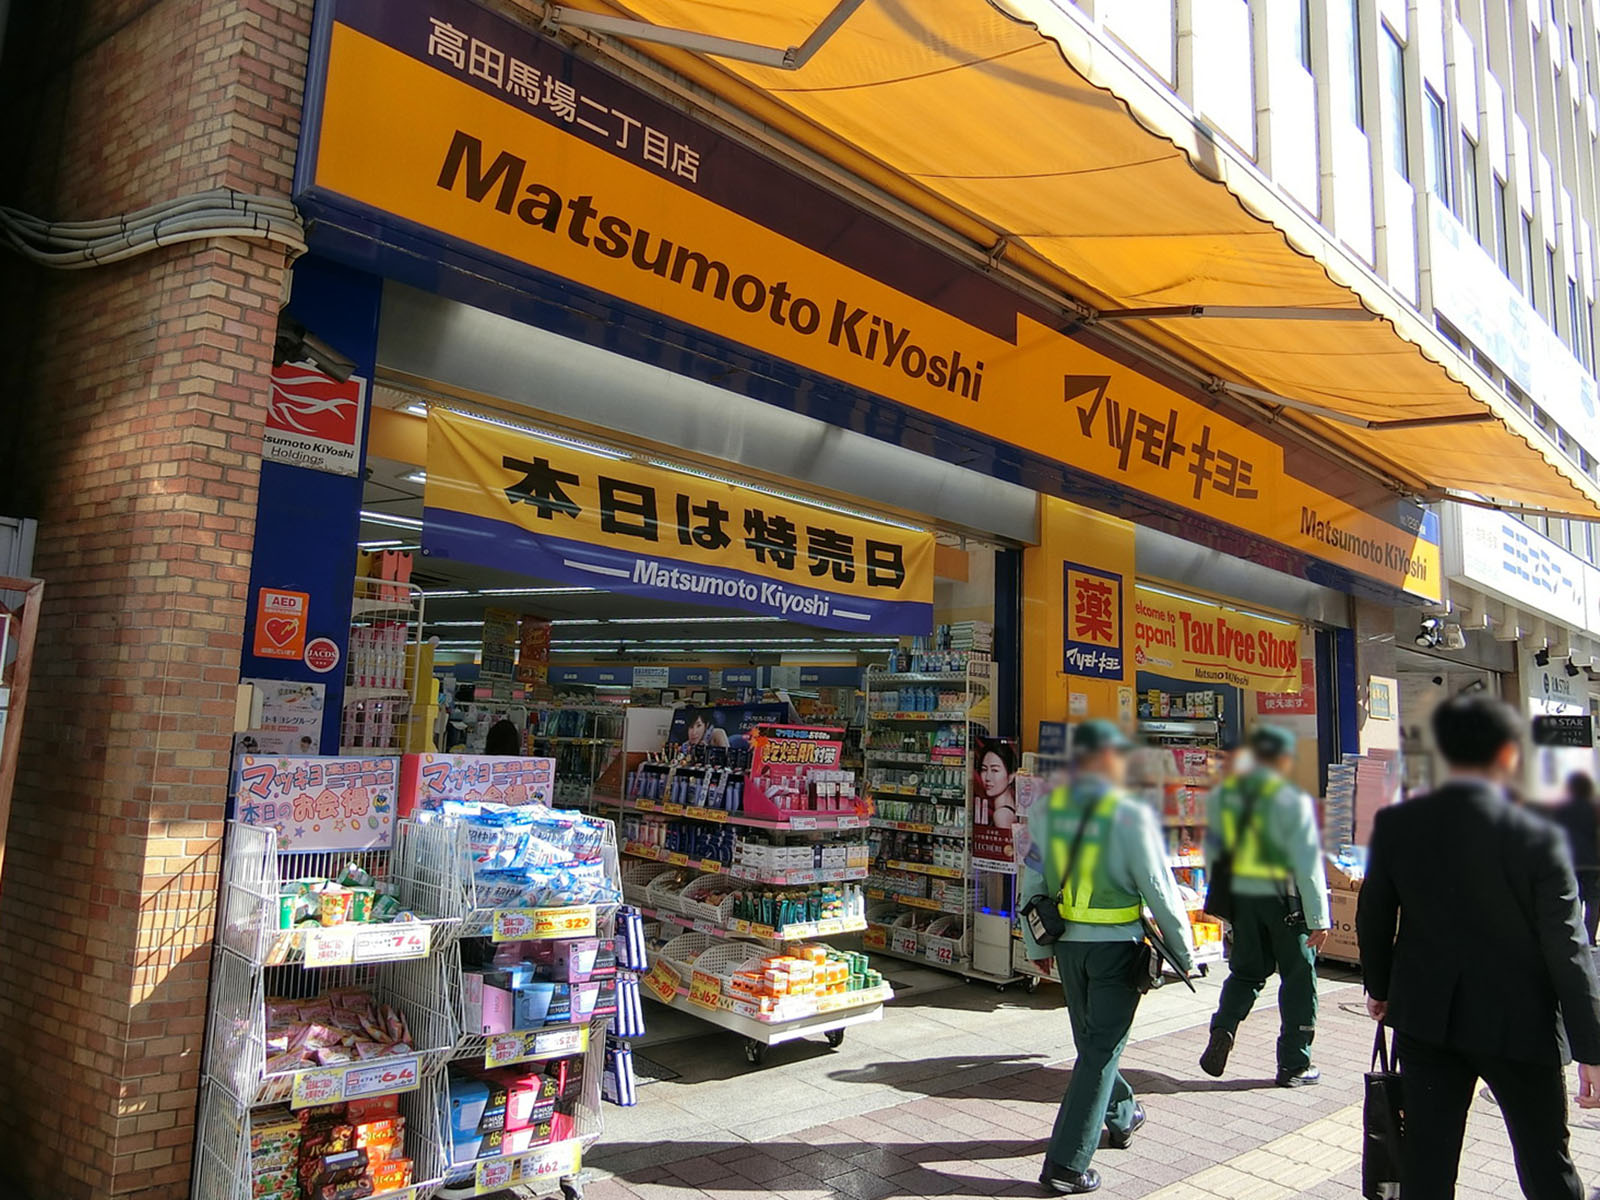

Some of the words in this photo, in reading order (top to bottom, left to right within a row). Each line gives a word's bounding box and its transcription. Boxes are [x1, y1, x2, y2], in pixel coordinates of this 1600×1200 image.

[427, 16, 701, 184] 高田馬場二丁目店
[435, 130, 822, 336] Matsumoto
[826, 298, 986, 403] KiYoshi
[263, 433, 311, 451] tsumoto
[312, 442, 354, 460] KiYoshi
[1063, 374, 1260, 500] マツモトキヨシ
[270, 445, 325, 466] Holdings
[501, 455, 905, 591] 本日は特売日
[1300, 505, 1383, 565] Matsumoto
[1385, 542, 1428, 582] KiYoshi
[632, 558, 758, 603] Matsumoto
[760, 583, 830, 618] Kiyoshi
[271, 596, 297, 608] AED
[1074, 577, 1113, 643] 薬
[1135, 601, 1166, 621] elcome
[1167, 610, 1176, 624] to
[1135, 622, 1176, 649] apan!
[1179, 610, 1215, 656] Tax
[1217, 617, 1256, 665] Free
[1258, 629, 1298, 672] Shop
[1066, 647, 1121, 673] マツモトキヨシ
[565, 917, 590, 928] 329
[392, 935, 421, 947] 74
[903, 938, 915, 950] 122
[938, 946, 951, 960] 122
[658, 981, 674, 1002] 307
[700, 991, 718, 1006] 162
[381, 1068, 414, 1082] 64
[538, 1161, 559, 1174] 462
